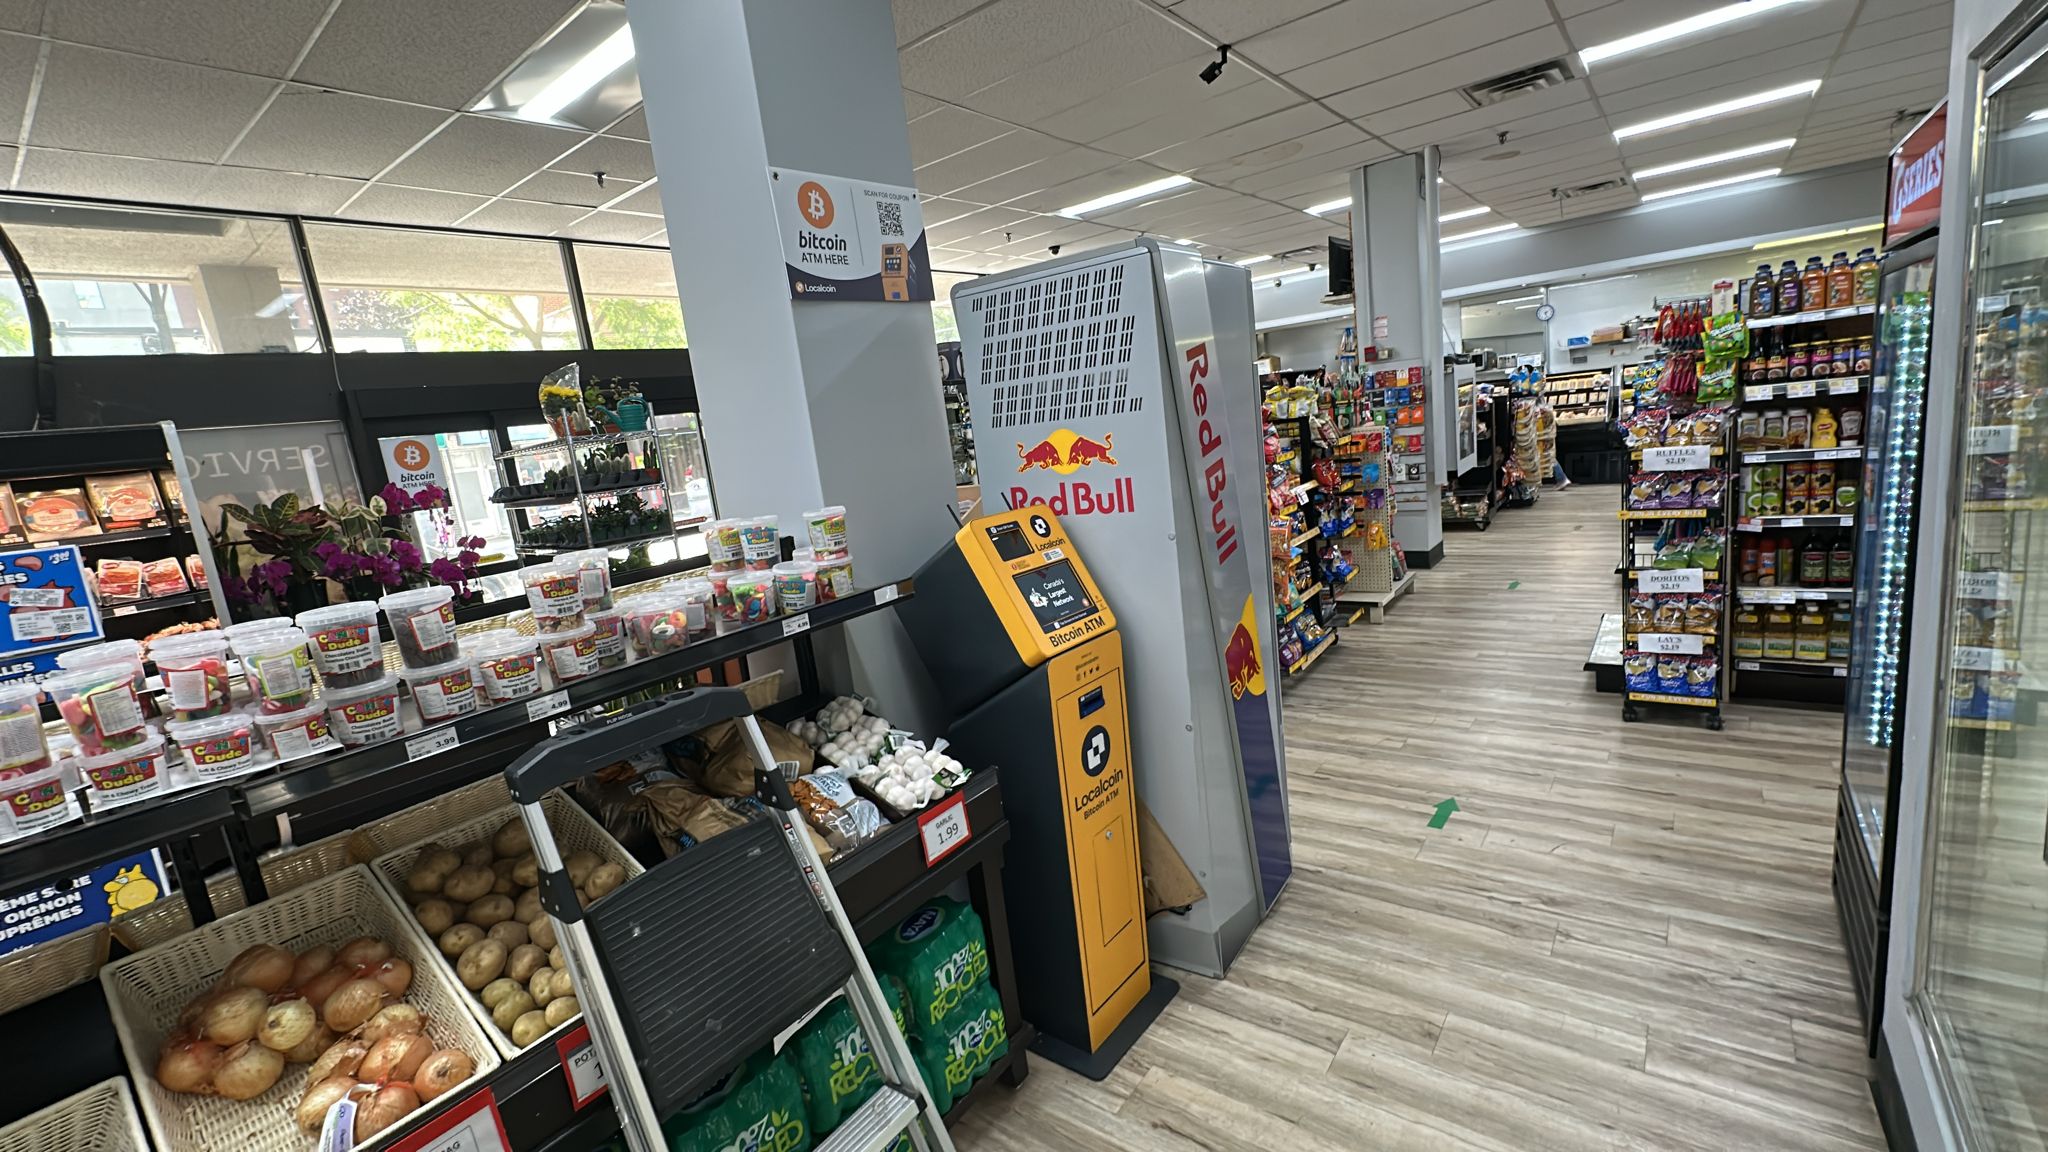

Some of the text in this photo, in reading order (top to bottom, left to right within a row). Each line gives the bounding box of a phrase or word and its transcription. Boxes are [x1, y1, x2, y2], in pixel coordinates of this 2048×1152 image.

[864, 189, 910, 202] SCAN FOR COUPON
[799, 230, 847, 252] bitcoin
[801, 252, 849, 266] ATM HERE
[804, 283, 837, 294] Localcoin
[1186, 342, 1238, 566] Red Bull
[1656, 449, 1697, 457] RUFFLES
[1665, 457, 1686, 465] $2.19
[401, 471, 435, 483] bitcoin
[1072, 477, 1135, 516] Bull
[1035, 537, 1066, 552] Localcoin
[1043, 578, 1065, 590] Canada's
[1651, 574, 1690, 583] DORITOS
[550, 588, 574, 598] Dude
[1048, 587, 1067, 599] Largest
[1053, 595, 1075, 608] Network
[1049, 626, 1084, 648] Bitcoin
[1084, 615, 1106, 634] ATM
[328, 638, 361, 651] Dude
[1657, 635, 1682, 643] LAY'S
[1660, 643, 1680, 651] $2.19
[504, 667, 530, 679] Dude
[551, 700, 568, 710] 4.99
[355, 708, 388, 722] Dude
[436, 737, 456, 748] 3.99
[205, 750, 242, 764] Dude
[101, 773, 146, 791] Dude
[1074, 768, 1124, 812] Localcoin
[1084, 788, 1119, 820] Bitcoin ATM
[935, 814, 954, 830] GARLIC
[937, 824, 959, 846] 1.99
[4, 891, 82, 924] OIGNON
[934, 942, 973, 993] 100%
[930, 949, 988, 1026] RECYCLED
[949, 1009, 992, 1061] 100%
